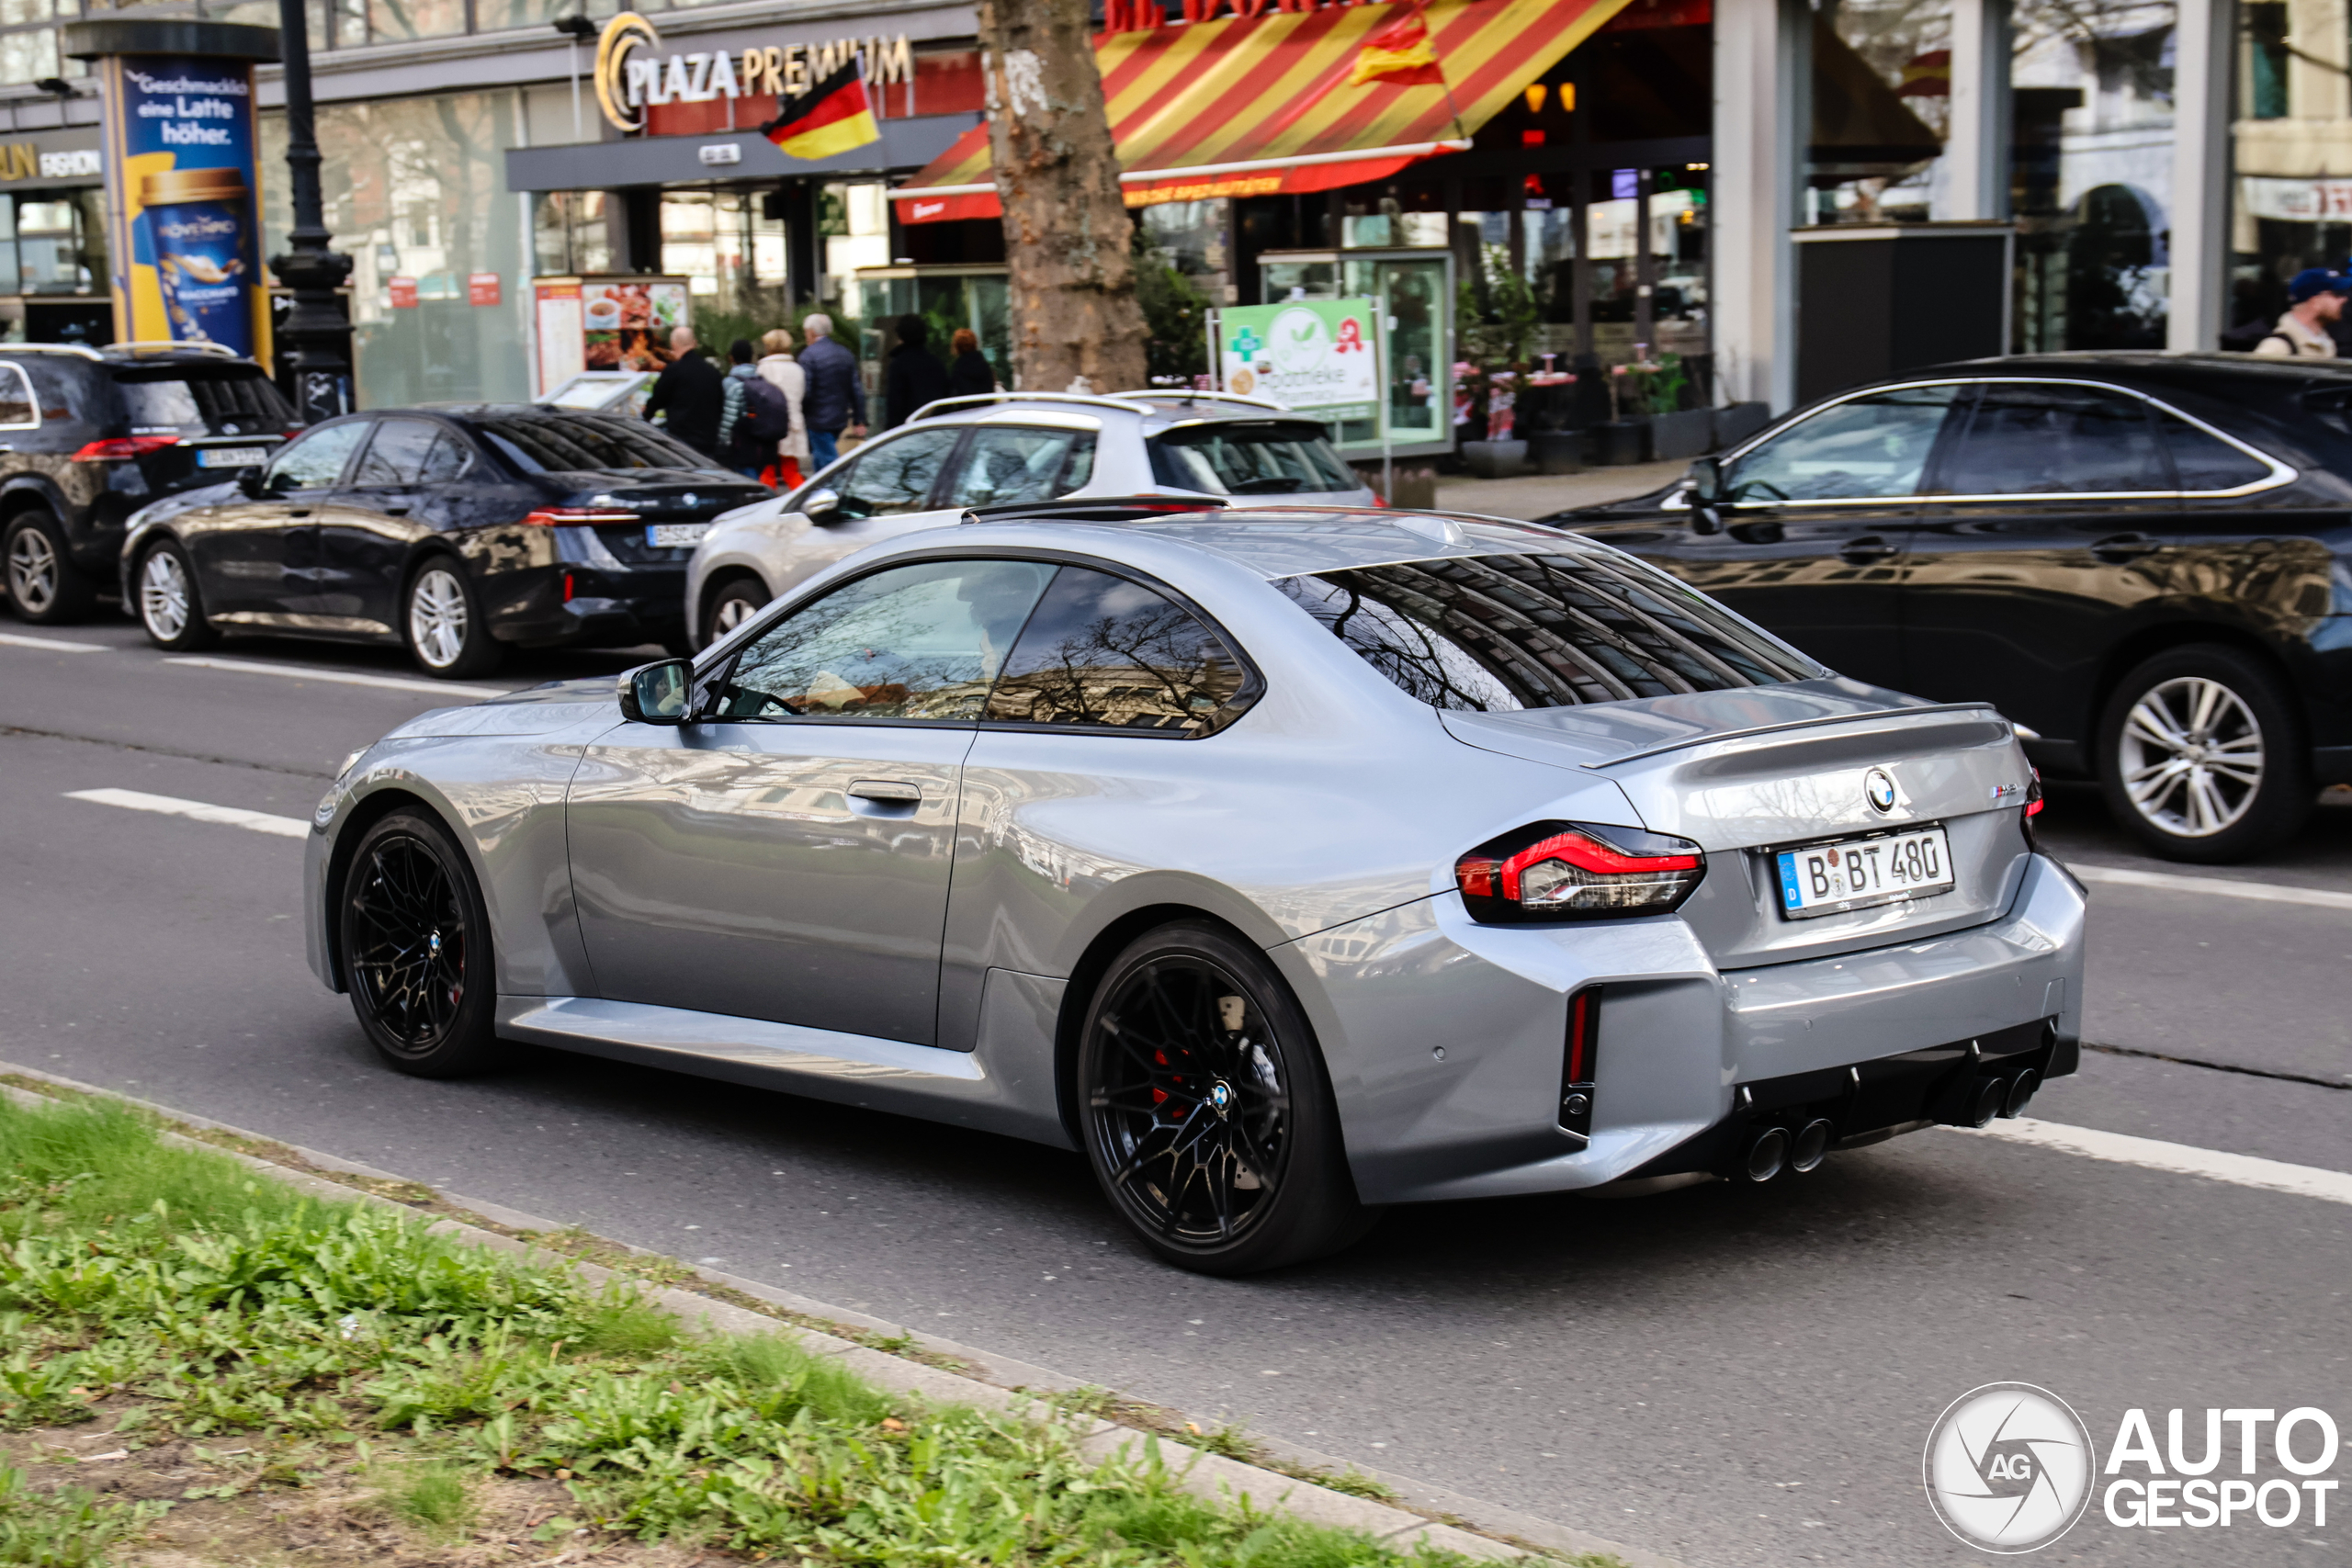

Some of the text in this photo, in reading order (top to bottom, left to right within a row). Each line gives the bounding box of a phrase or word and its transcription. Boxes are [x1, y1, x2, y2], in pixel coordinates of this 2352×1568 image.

[627, 33, 914, 107] PLAZA PREMIUM
[138, 96, 233, 118] eine Latte
[161, 120, 232, 144] höher.
[1807, 856, 1829, 898] B
[1846, 845, 1880, 892] BT
[1891, 837, 1939, 884] 480
